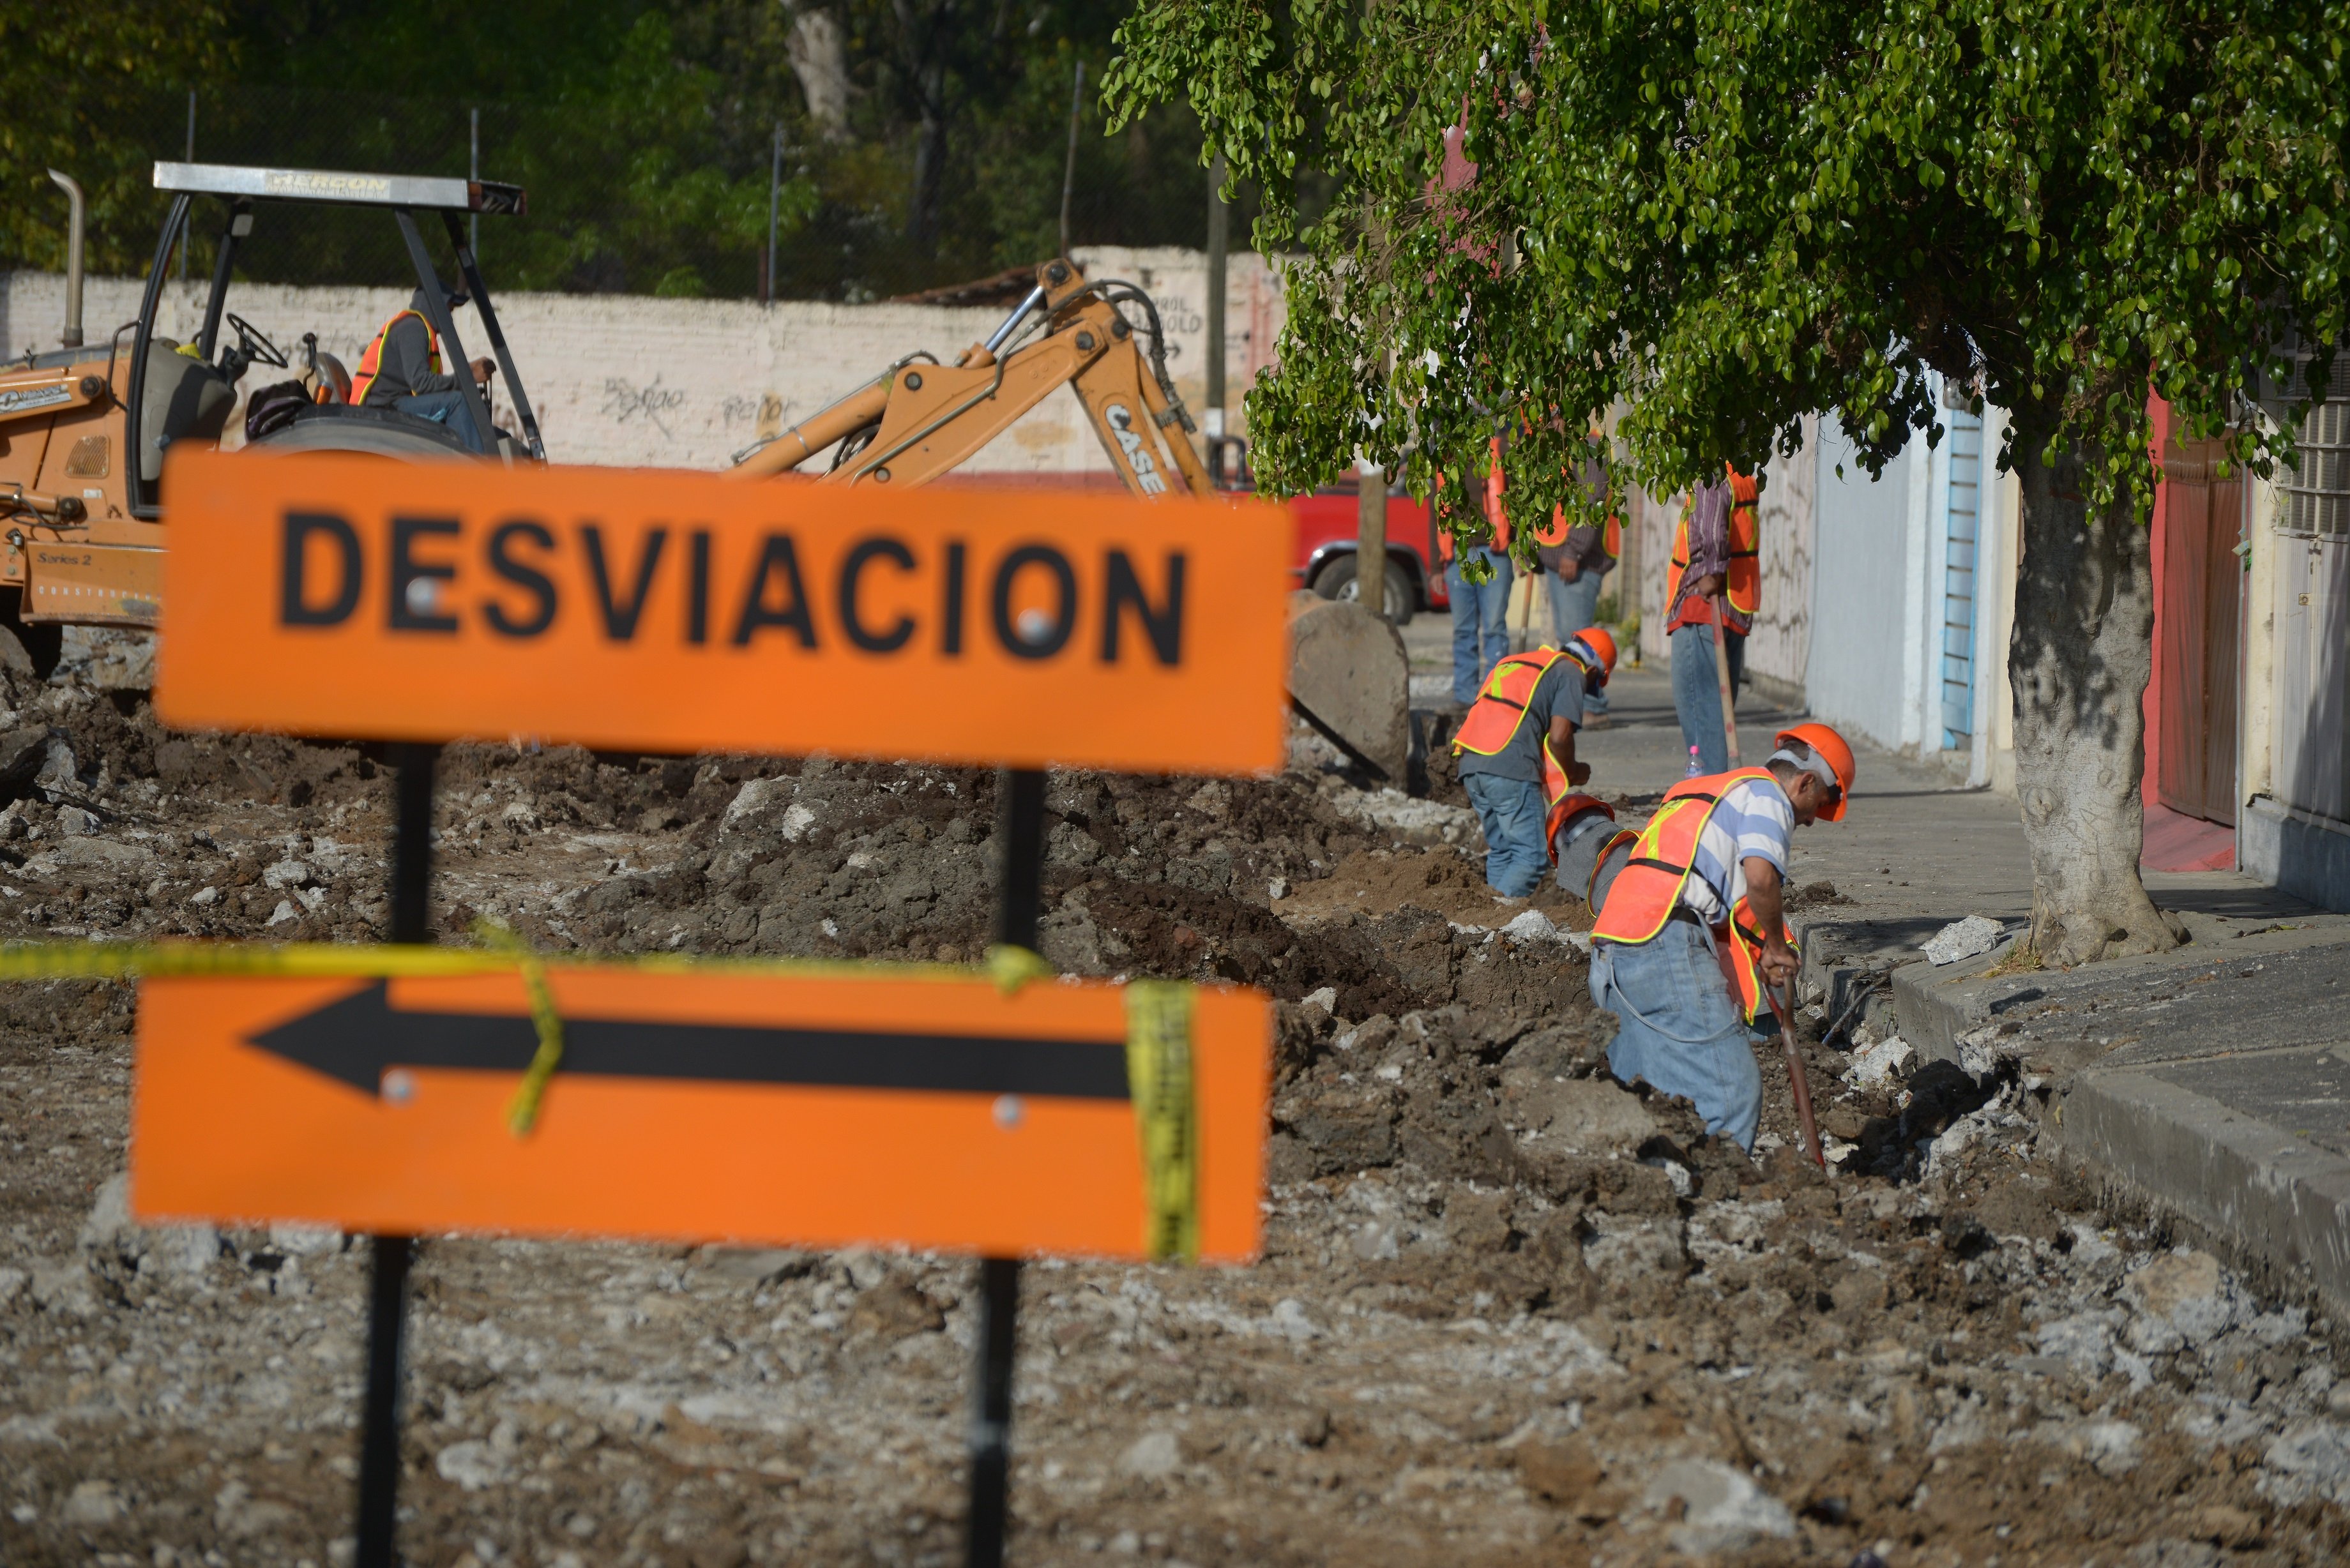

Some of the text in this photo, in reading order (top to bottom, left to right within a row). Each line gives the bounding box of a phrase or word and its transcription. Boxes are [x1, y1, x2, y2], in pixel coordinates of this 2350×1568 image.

[1105, 404, 1167, 496] CASE
[38, 552, 92, 566] Series 2
[280, 509, 1189, 668] DESVIACION
